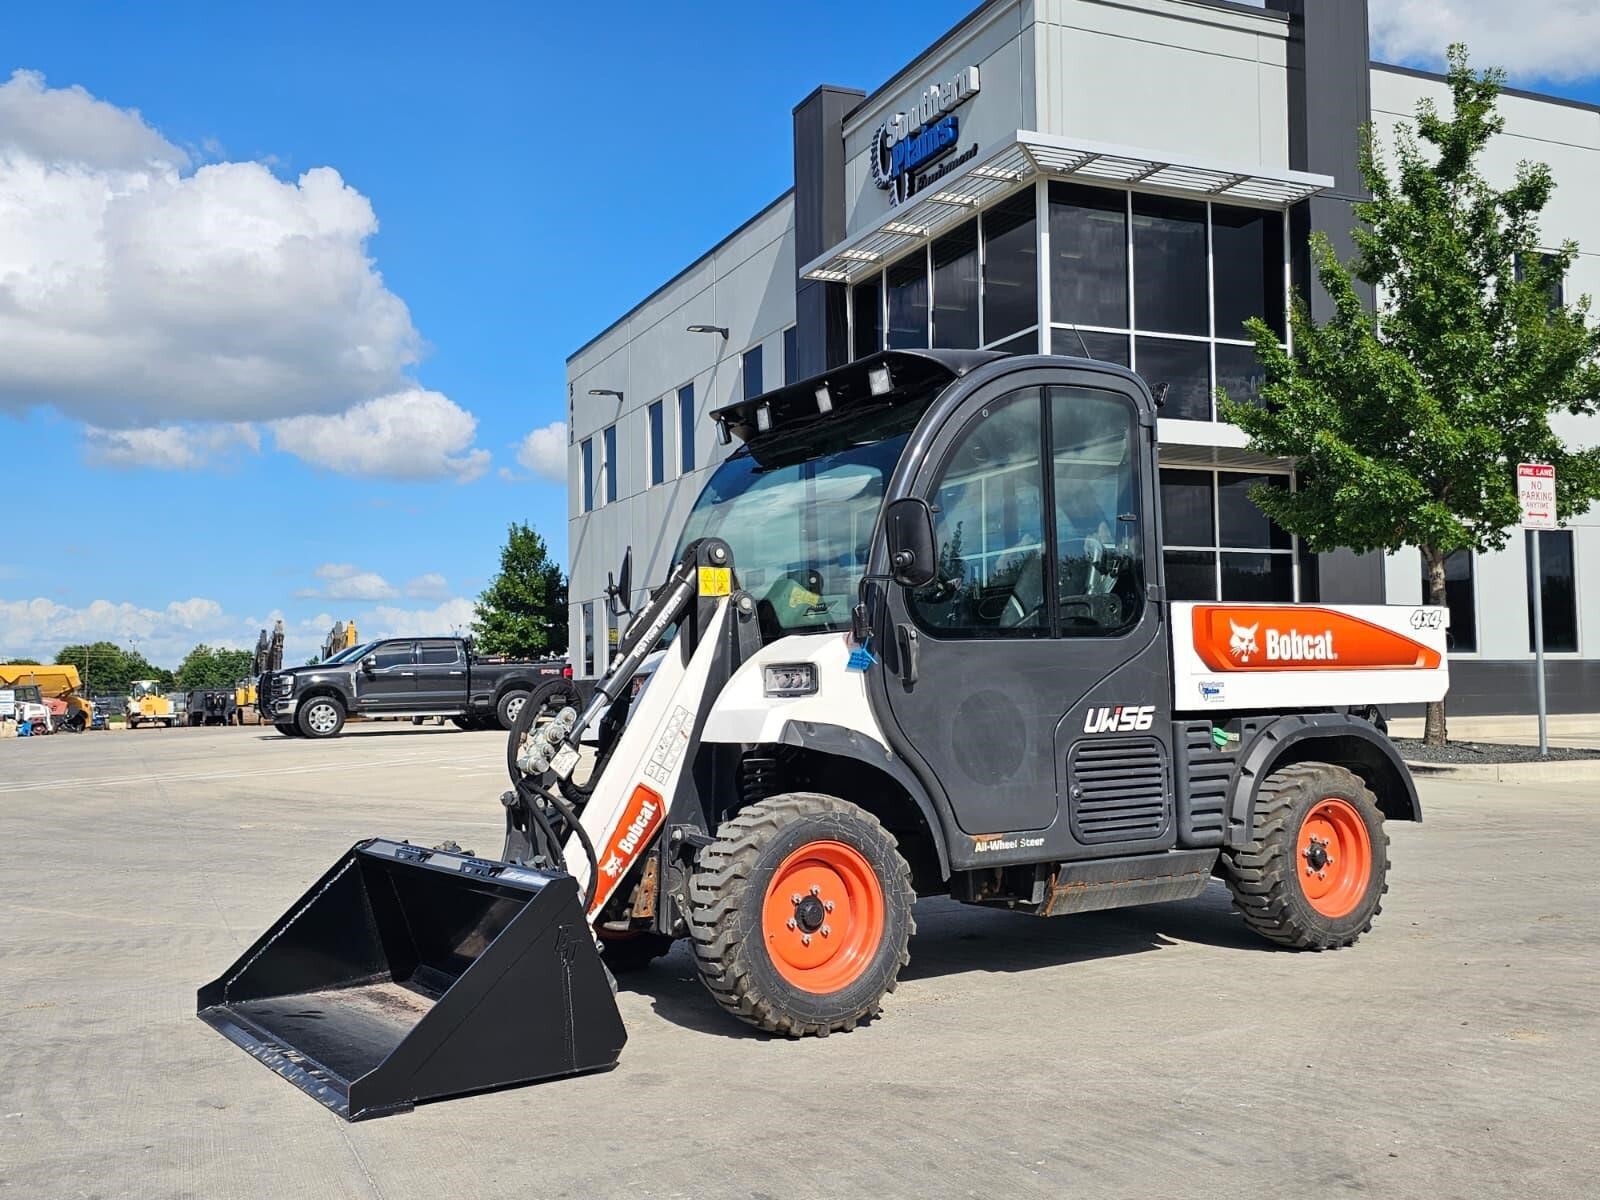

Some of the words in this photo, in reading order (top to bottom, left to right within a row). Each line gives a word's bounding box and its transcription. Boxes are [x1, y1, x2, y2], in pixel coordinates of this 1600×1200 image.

[886, 65, 980, 147] Southern
[892, 116, 959, 176] Plains
[1521, 491, 1553, 502] PARKING
[1531, 481, 1542, 490] NO
[1409, 609, 1442, 630] 4x4
[1265, 628, 1336, 660] Bobcat
[1083, 705, 1156, 734] UW56
[617, 799, 657, 855] Bobcat
[974, 839, 1018, 853] All-Wheel
[1019, 837, 1045, 848] Steer
